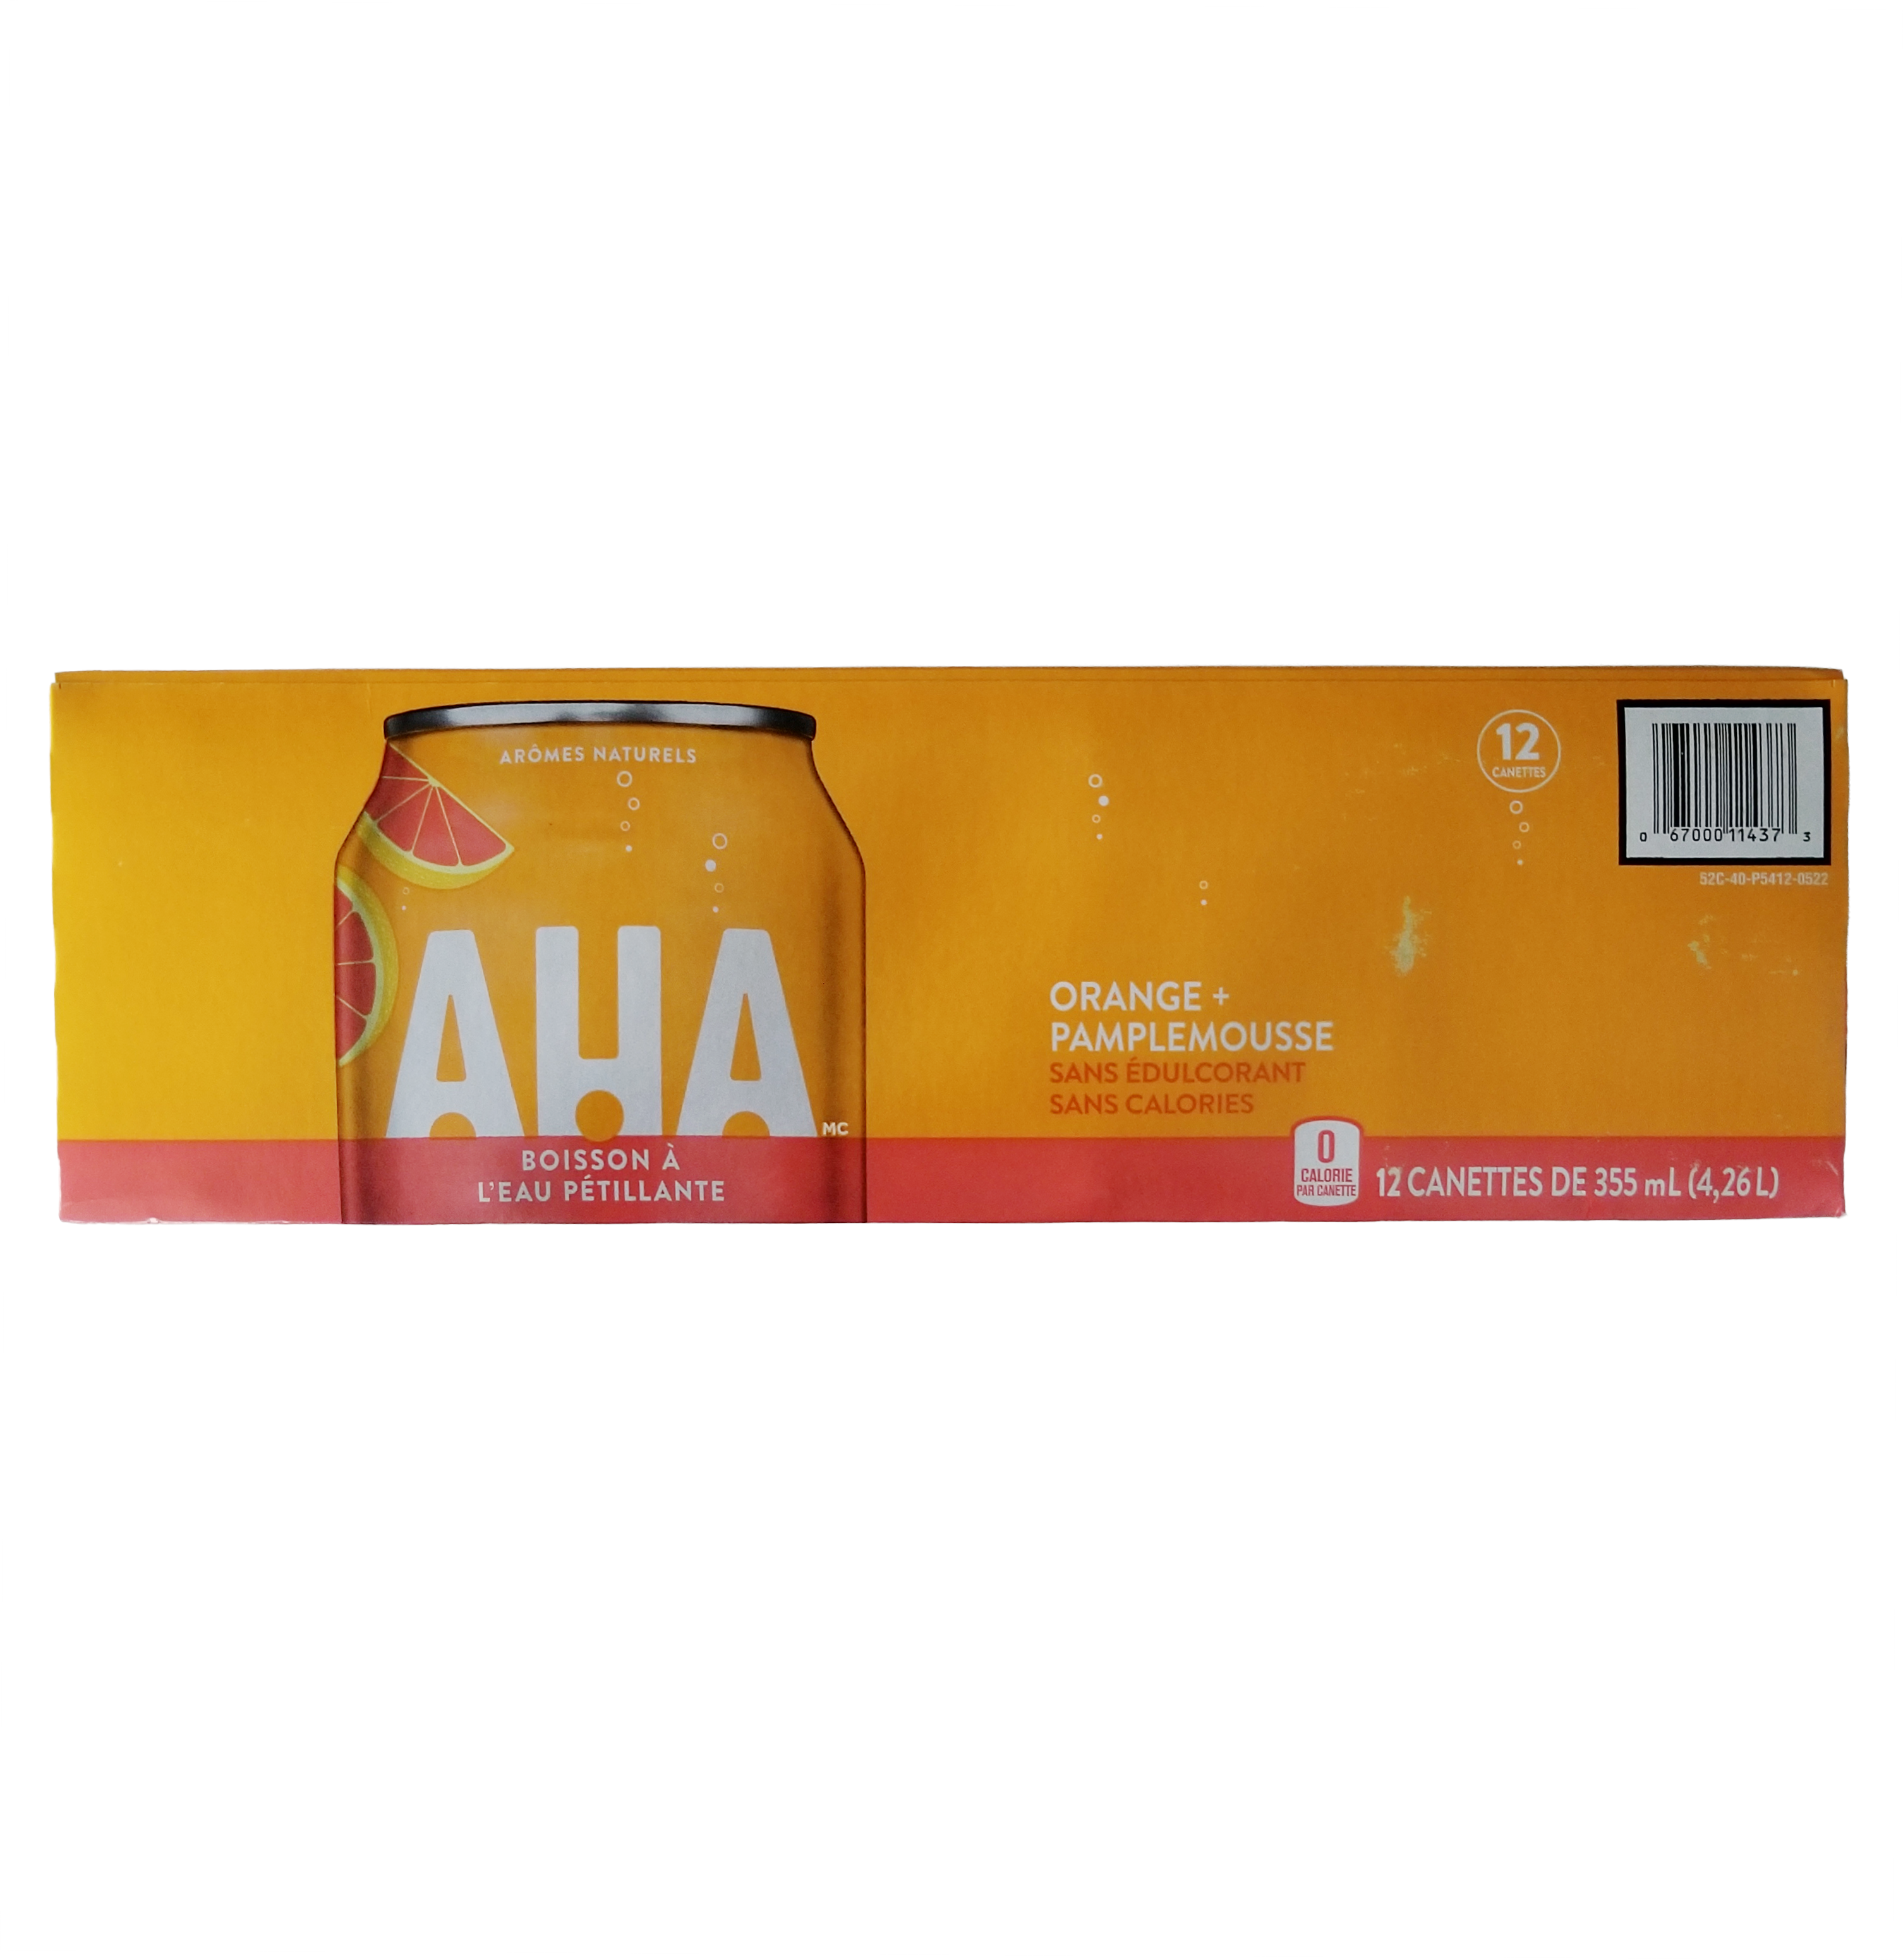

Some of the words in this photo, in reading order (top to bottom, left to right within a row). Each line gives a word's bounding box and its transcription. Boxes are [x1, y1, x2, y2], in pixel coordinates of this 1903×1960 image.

[500, 744, 585, 764] ARÔMES
[593, 746, 698, 764] NATURELS
[1496, 723, 1540, 761] 12
[1492, 766, 1546, 778] CANETTES
[1640, 833, 1647, 842] 0
[1803, 833, 1811, 842] 3
[1049, 981, 1202, 1011] ORANGE
[1212, 987, 1229, 1005] +
[385, 925, 818, 1138] AHA
[1051, 1021, 1334, 1052] PAMPLEMOUSSE
[1049, 1062, 1118, 1083] SANS
[1126, 1057, 1306, 1084] ÉDULCORANT
[1049, 1093, 1118, 1114] SANS
[1126, 1093, 1254, 1114] CALORIES
[822, 1122, 849, 1136] MC
[522, 1150, 649, 1171] BOISSON
[661, 1143, 680, 1170] À
[1317, 1129, 1335, 1163] 0
[564, 1173, 725, 1203] PÉTILLANTE
[1301, 1168, 1353, 1182] CALORIE
[1376, 1167, 1401, 1197] 12
[1407, 1166, 1543, 1196] CANETTES
[1552, 1167, 1588, 1196] DE
[1594, 1166, 1638, 1196] 355
[1645, 1167, 1681, 1196] mL
[1296, 1185, 1315, 1196] PAR
[1317, 1184, 1356, 1196] CANETTE
